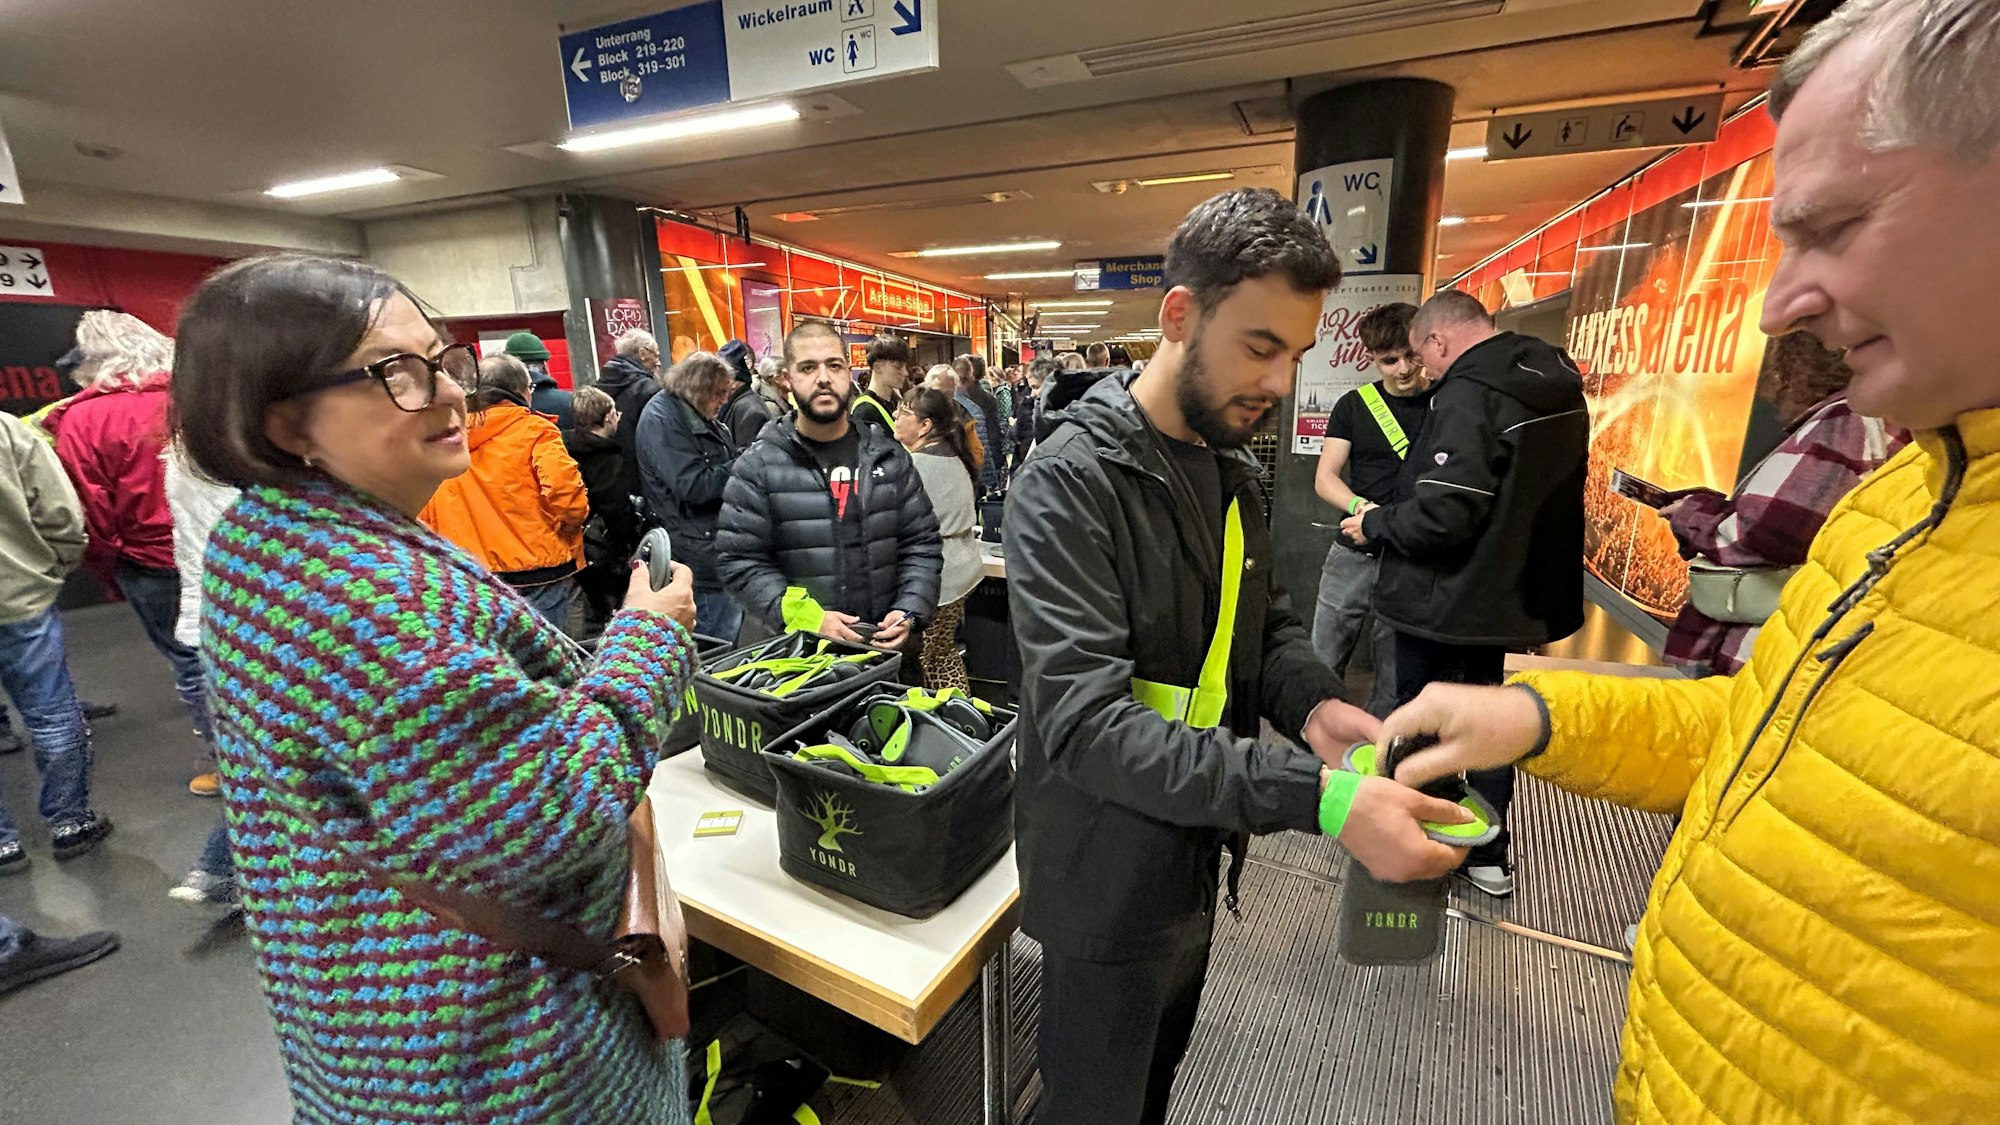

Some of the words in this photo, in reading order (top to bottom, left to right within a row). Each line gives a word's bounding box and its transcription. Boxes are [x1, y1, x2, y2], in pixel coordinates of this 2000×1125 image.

[738, 0, 832, 30] Wickelraum
[596, 28, 651, 49] Unterrang
[860, 30, 872, 39] WC
[598, 49, 628, 66] Block
[635, 36, 685, 58] 219-220
[808, 47, 835, 66] WC
[600, 66, 630, 84] Block
[638, 54, 686, 76] 319-301
[1344, 172, 1380, 192] WC
[1130, 274, 1162, 286] Shop
[870, 287, 930, 316] Arena-Shop
[1568, 302, 1649, 374] LANXESS
[1645, 282, 1748, 374] arena
[1369, 397, 1399, 437] YONDR
[701, 702, 762, 755] YONDR
[809, 847, 857, 878] YONDR
[1365, 911, 1418, 929] YONDR
